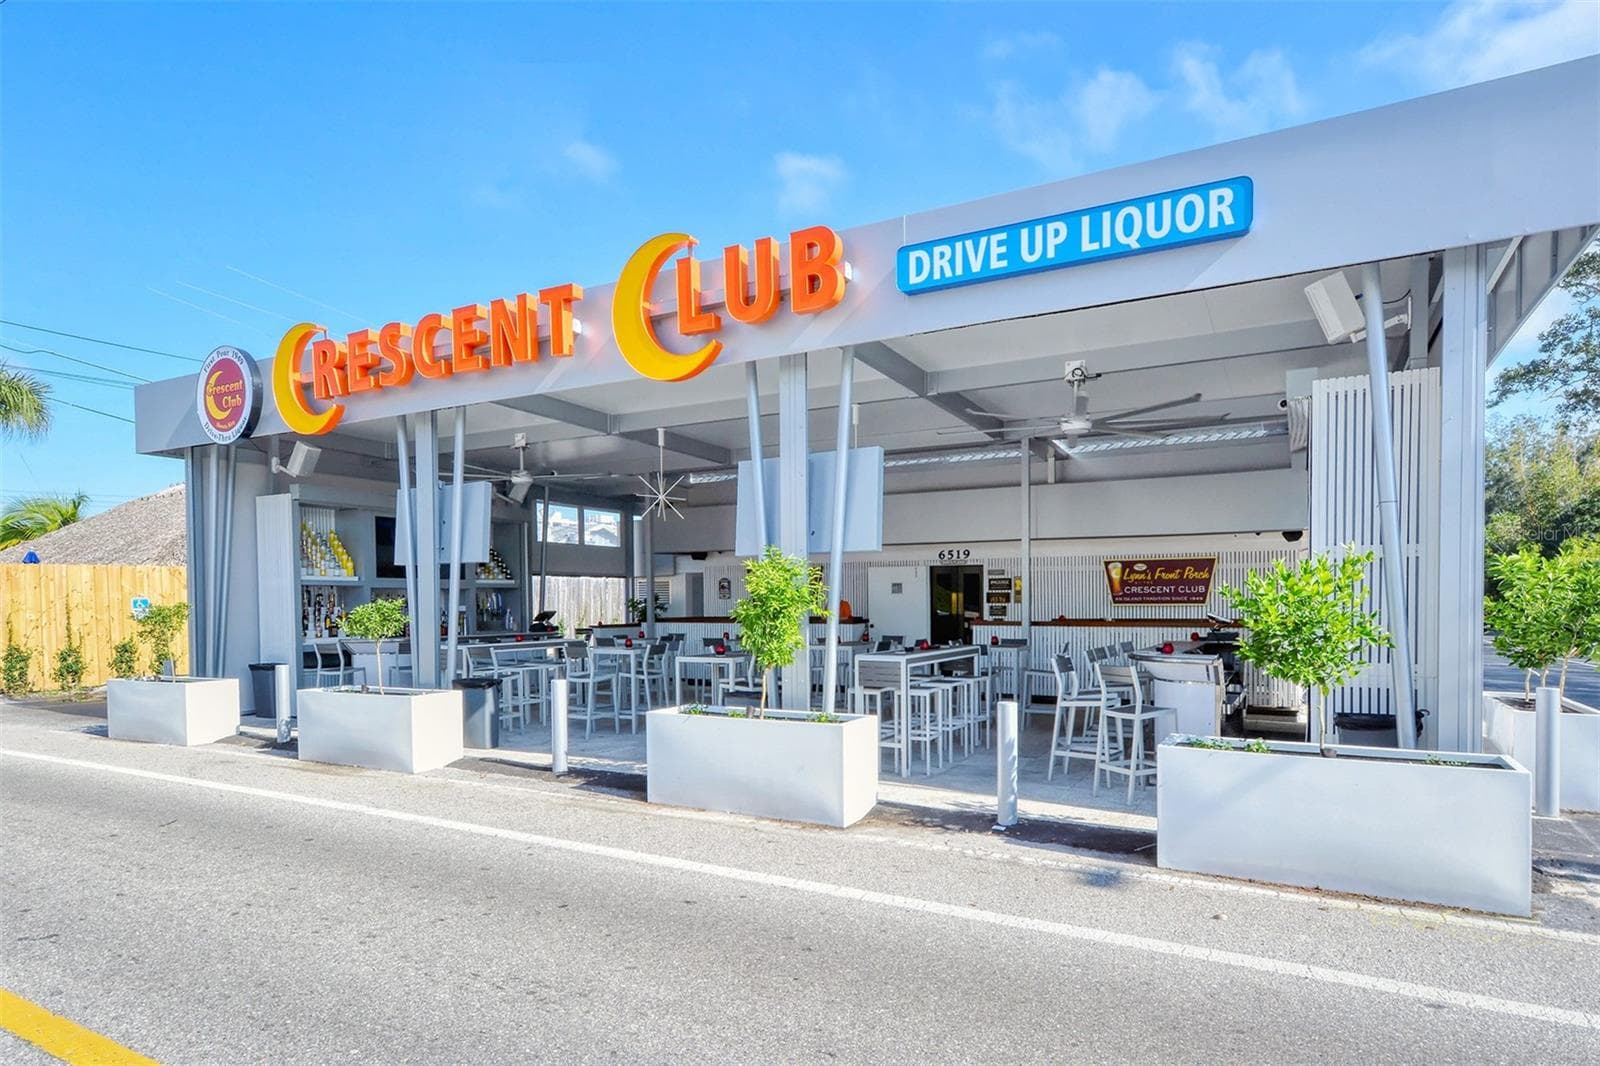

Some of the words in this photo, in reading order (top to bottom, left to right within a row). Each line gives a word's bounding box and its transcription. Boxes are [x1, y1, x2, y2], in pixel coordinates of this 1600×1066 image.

[908, 232, 1009, 285] DRIVE
[1020, 220, 1068, 263] UP
[1080, 186, 1235, 252] LIQUOR
[206, 380, 242, 395] Crescent
[222, 394, 242, 408] Club
[938, 549, 970, 560] 6519
[1154, 567, 1182, 580] Front
[1123, 586, 1176, 594] CRESCENT
[1178, 585, 1206, 593] CLUB
